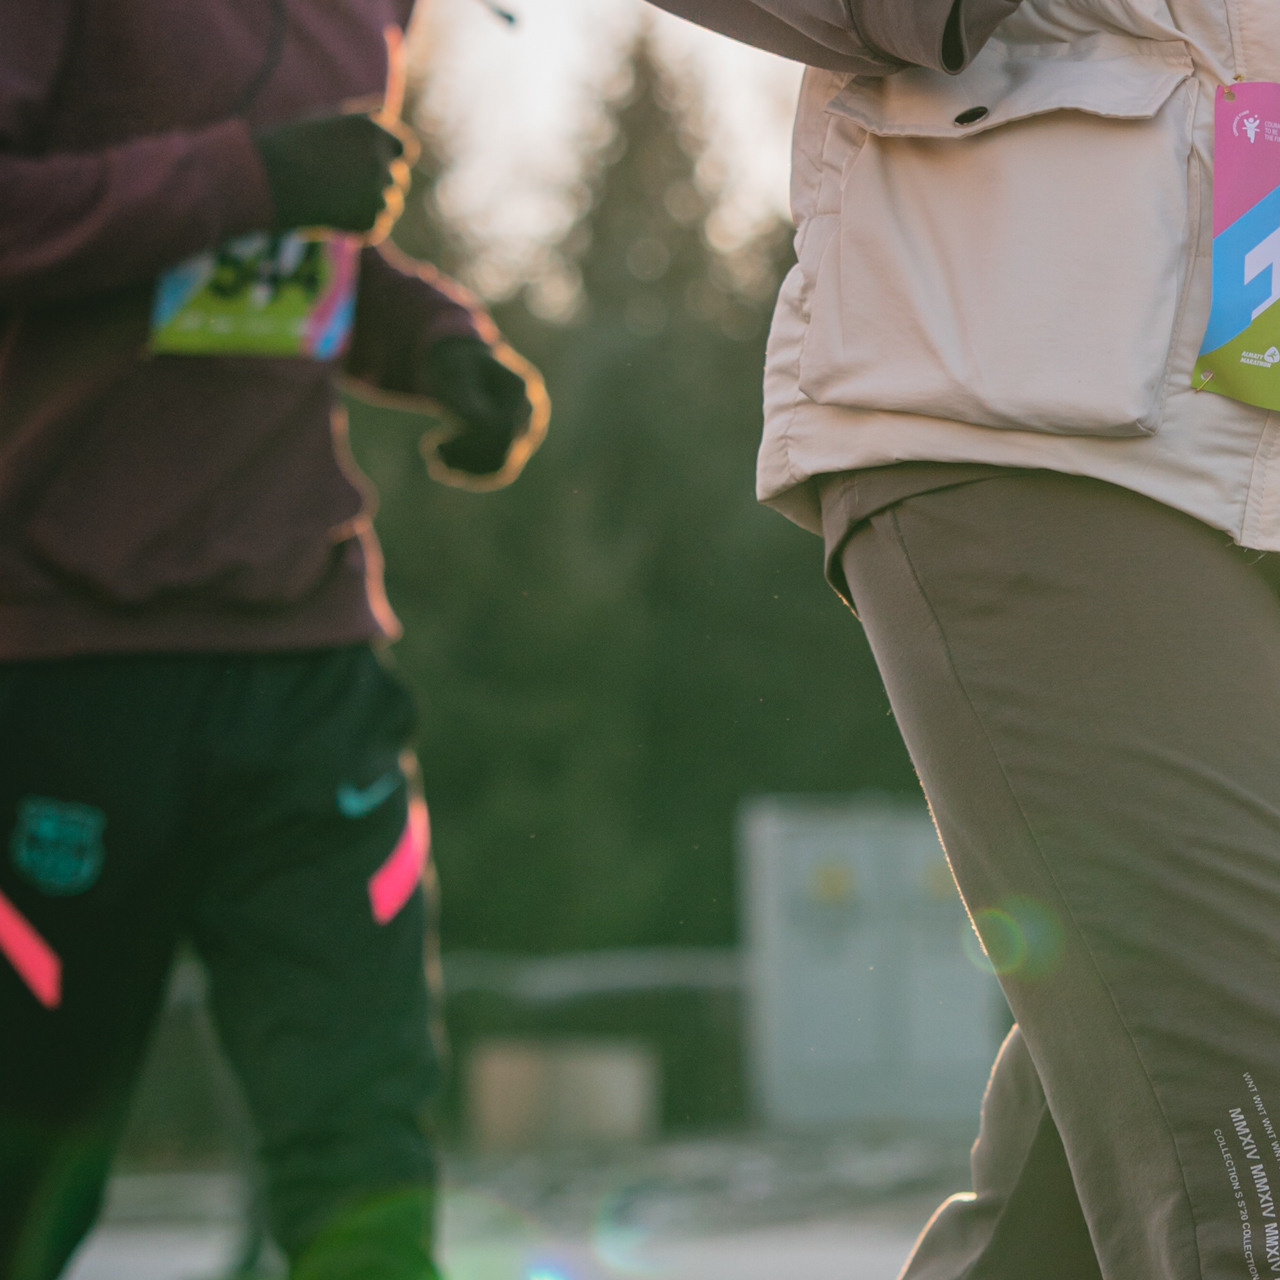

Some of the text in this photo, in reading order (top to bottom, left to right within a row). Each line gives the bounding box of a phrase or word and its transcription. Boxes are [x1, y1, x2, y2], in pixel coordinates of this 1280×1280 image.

[1240, 358, 1271, 368] MARATHON
[1242, 351, 1264, 359] ALMATY
[1243, 1072, 1257, 1092] WNT
[1253, 1095, 1267, 1115] WNT
[1262, 1118, 1276, 1138] WNT
[1228, 1107, 1260, 1160] MMXIV
[1250, 1163, 1276, 1218] MMXIV
[1213, 1128, 1241, 1190] COLLECTION
[1242, 1222, 1260, 1280] COLLECTION
